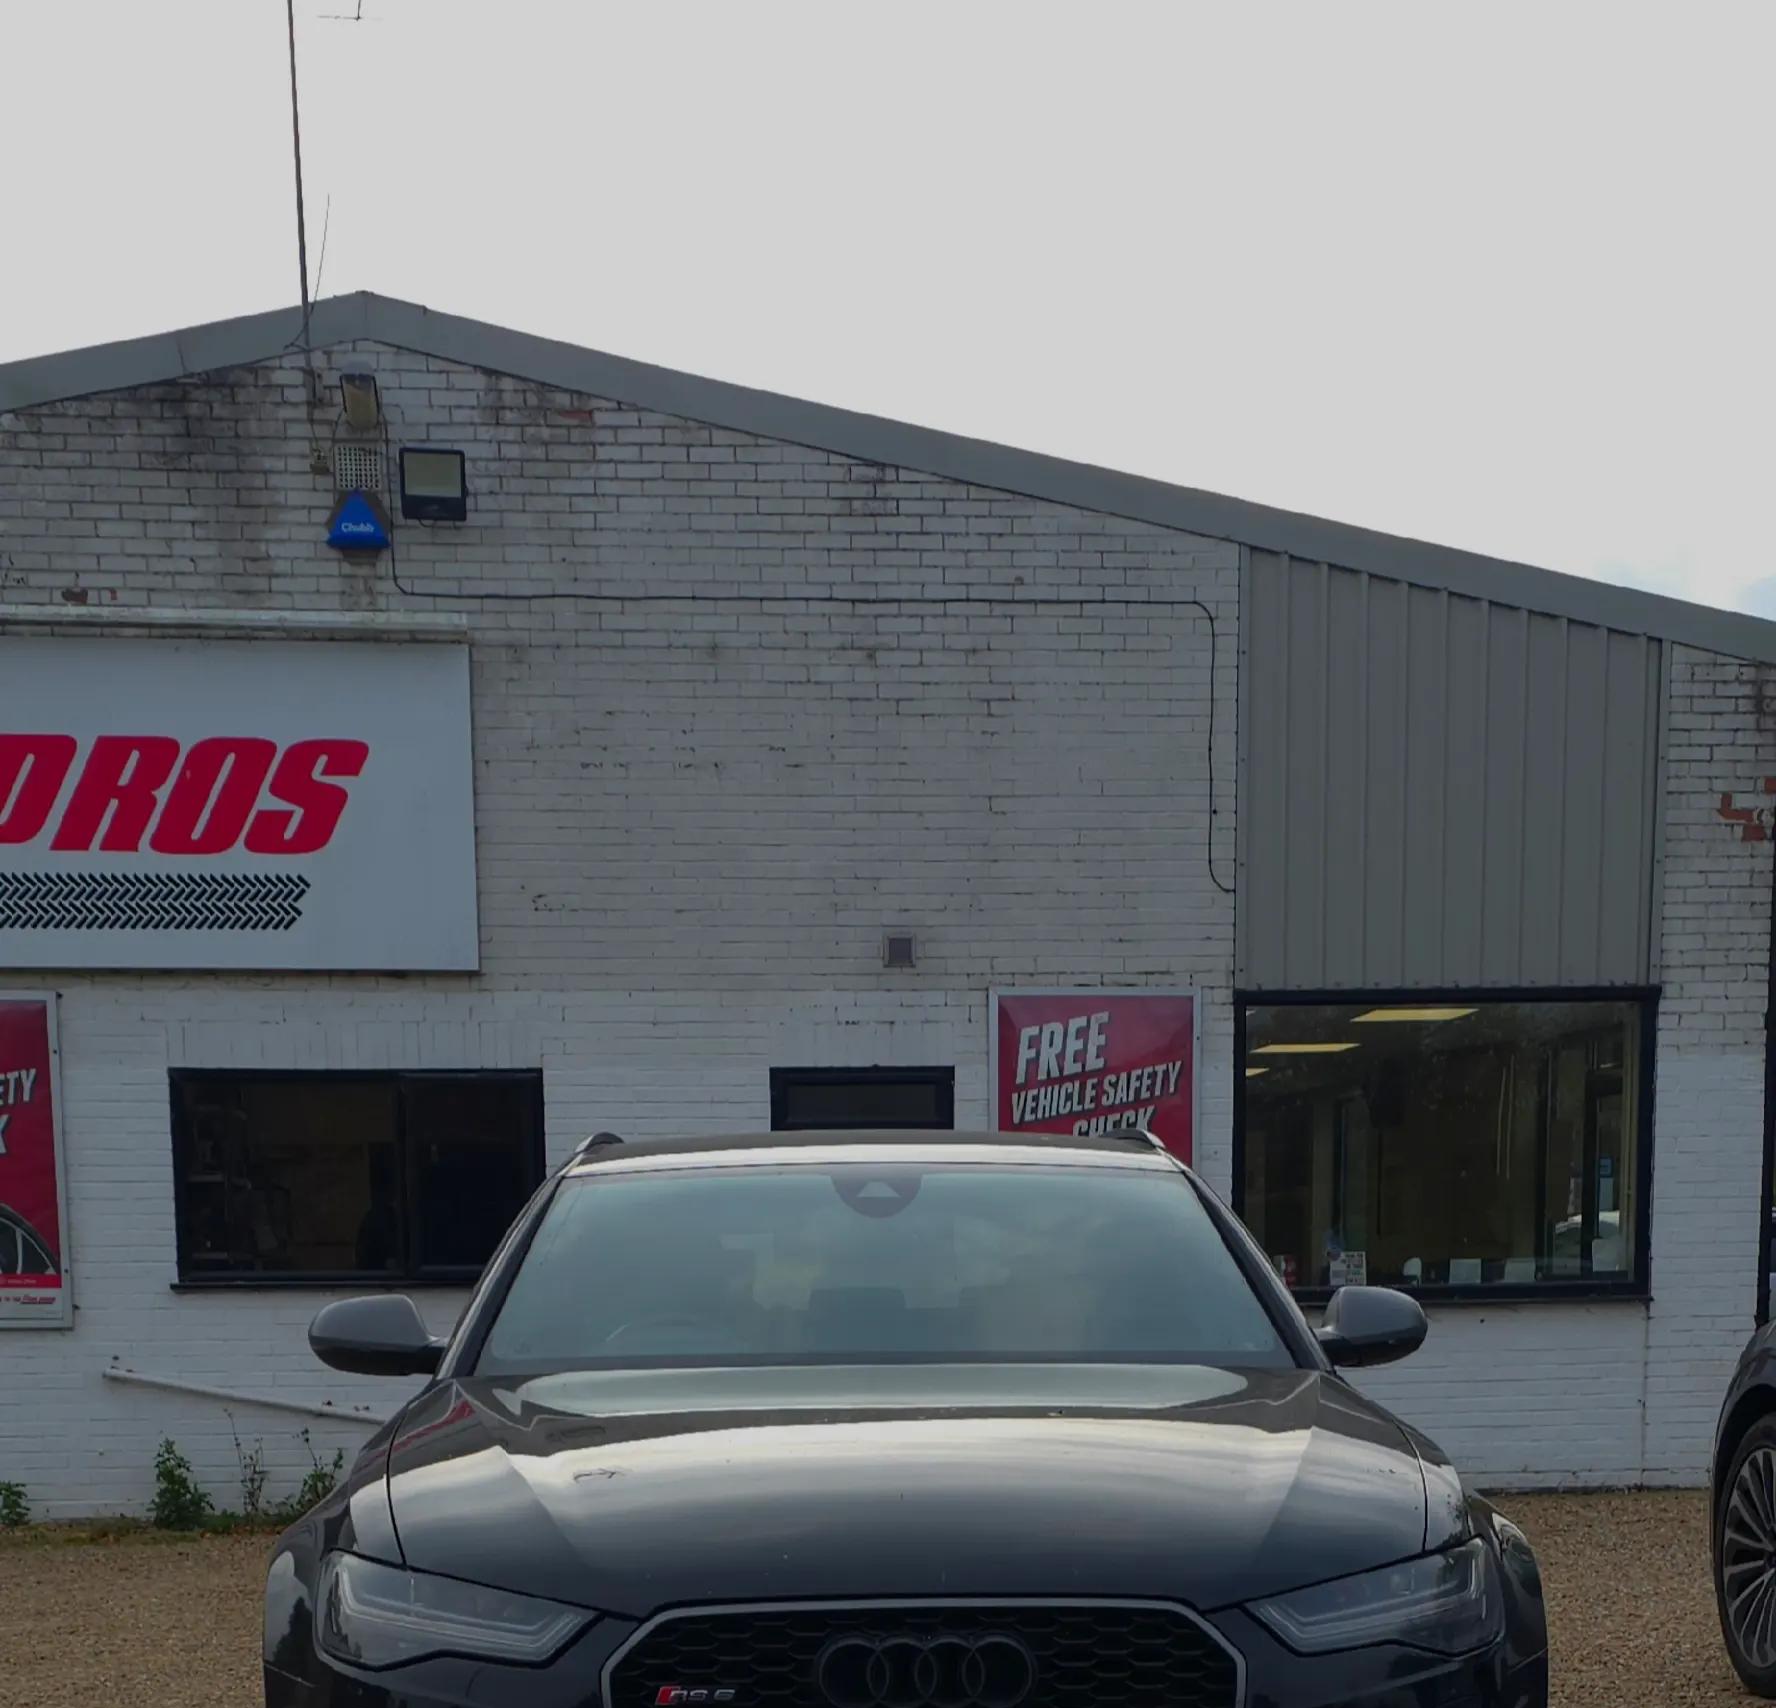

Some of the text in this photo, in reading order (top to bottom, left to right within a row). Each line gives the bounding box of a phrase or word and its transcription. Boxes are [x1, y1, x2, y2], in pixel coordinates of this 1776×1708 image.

[1016, 1011, 1109, 1085] FREE
[1012, 1060, 1182, 1125] VEHICLE SAFETY
